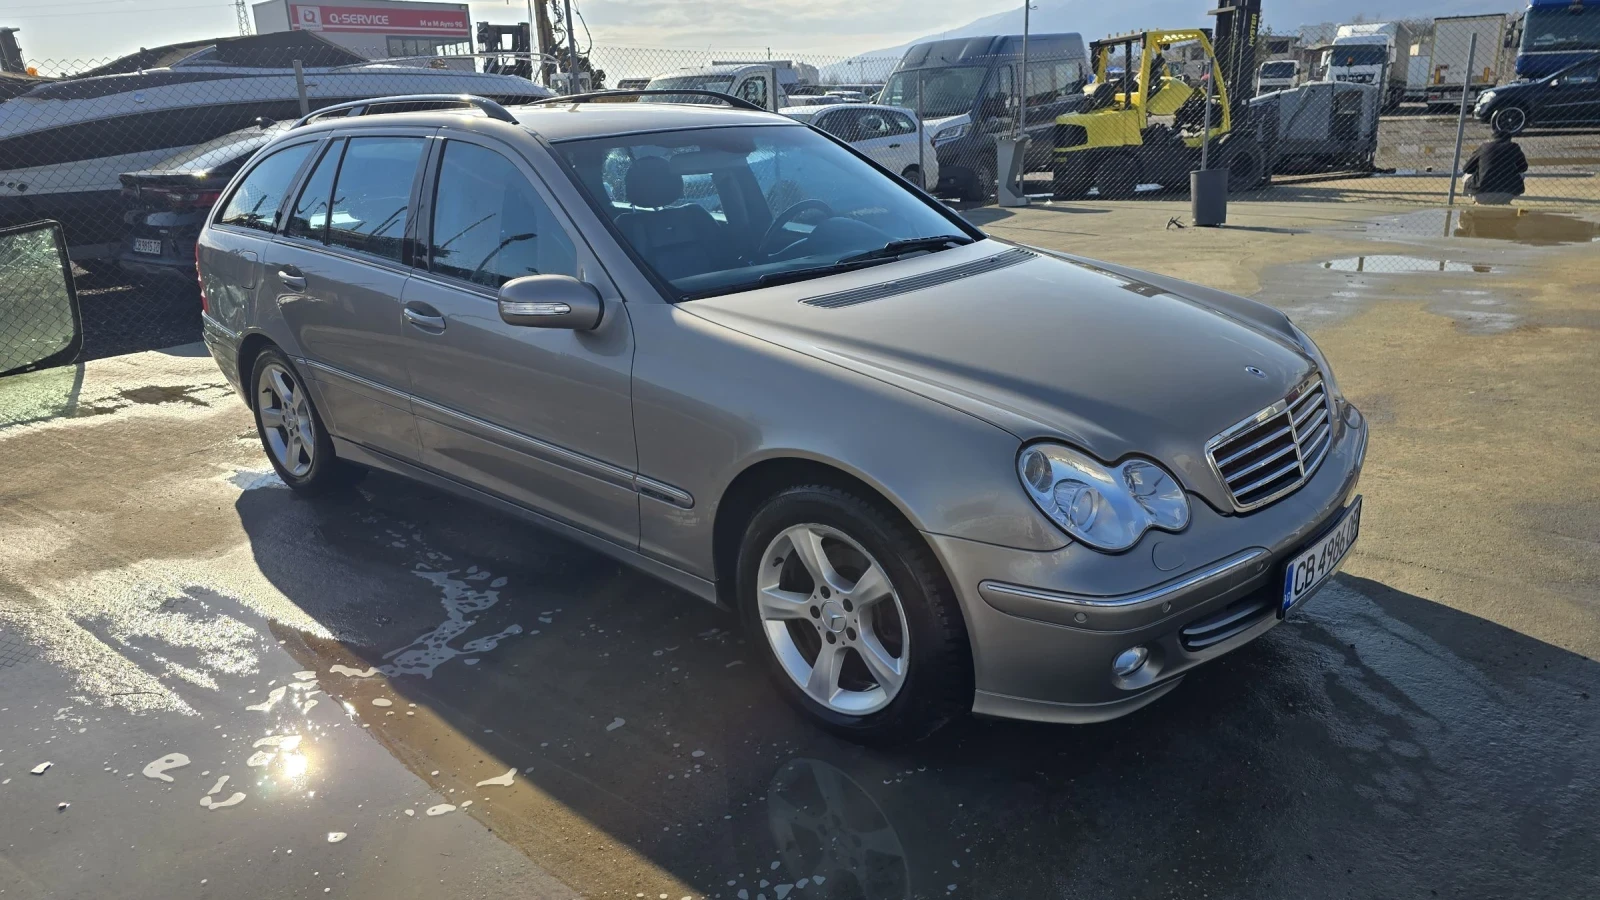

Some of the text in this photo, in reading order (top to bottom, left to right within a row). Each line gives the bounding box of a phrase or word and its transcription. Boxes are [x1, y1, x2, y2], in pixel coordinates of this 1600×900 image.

[1249, 13, 1258, 47] HYSTER
[1294, 553, 1316, 596] CB
[1318, 523, 1346, 575] 4986
